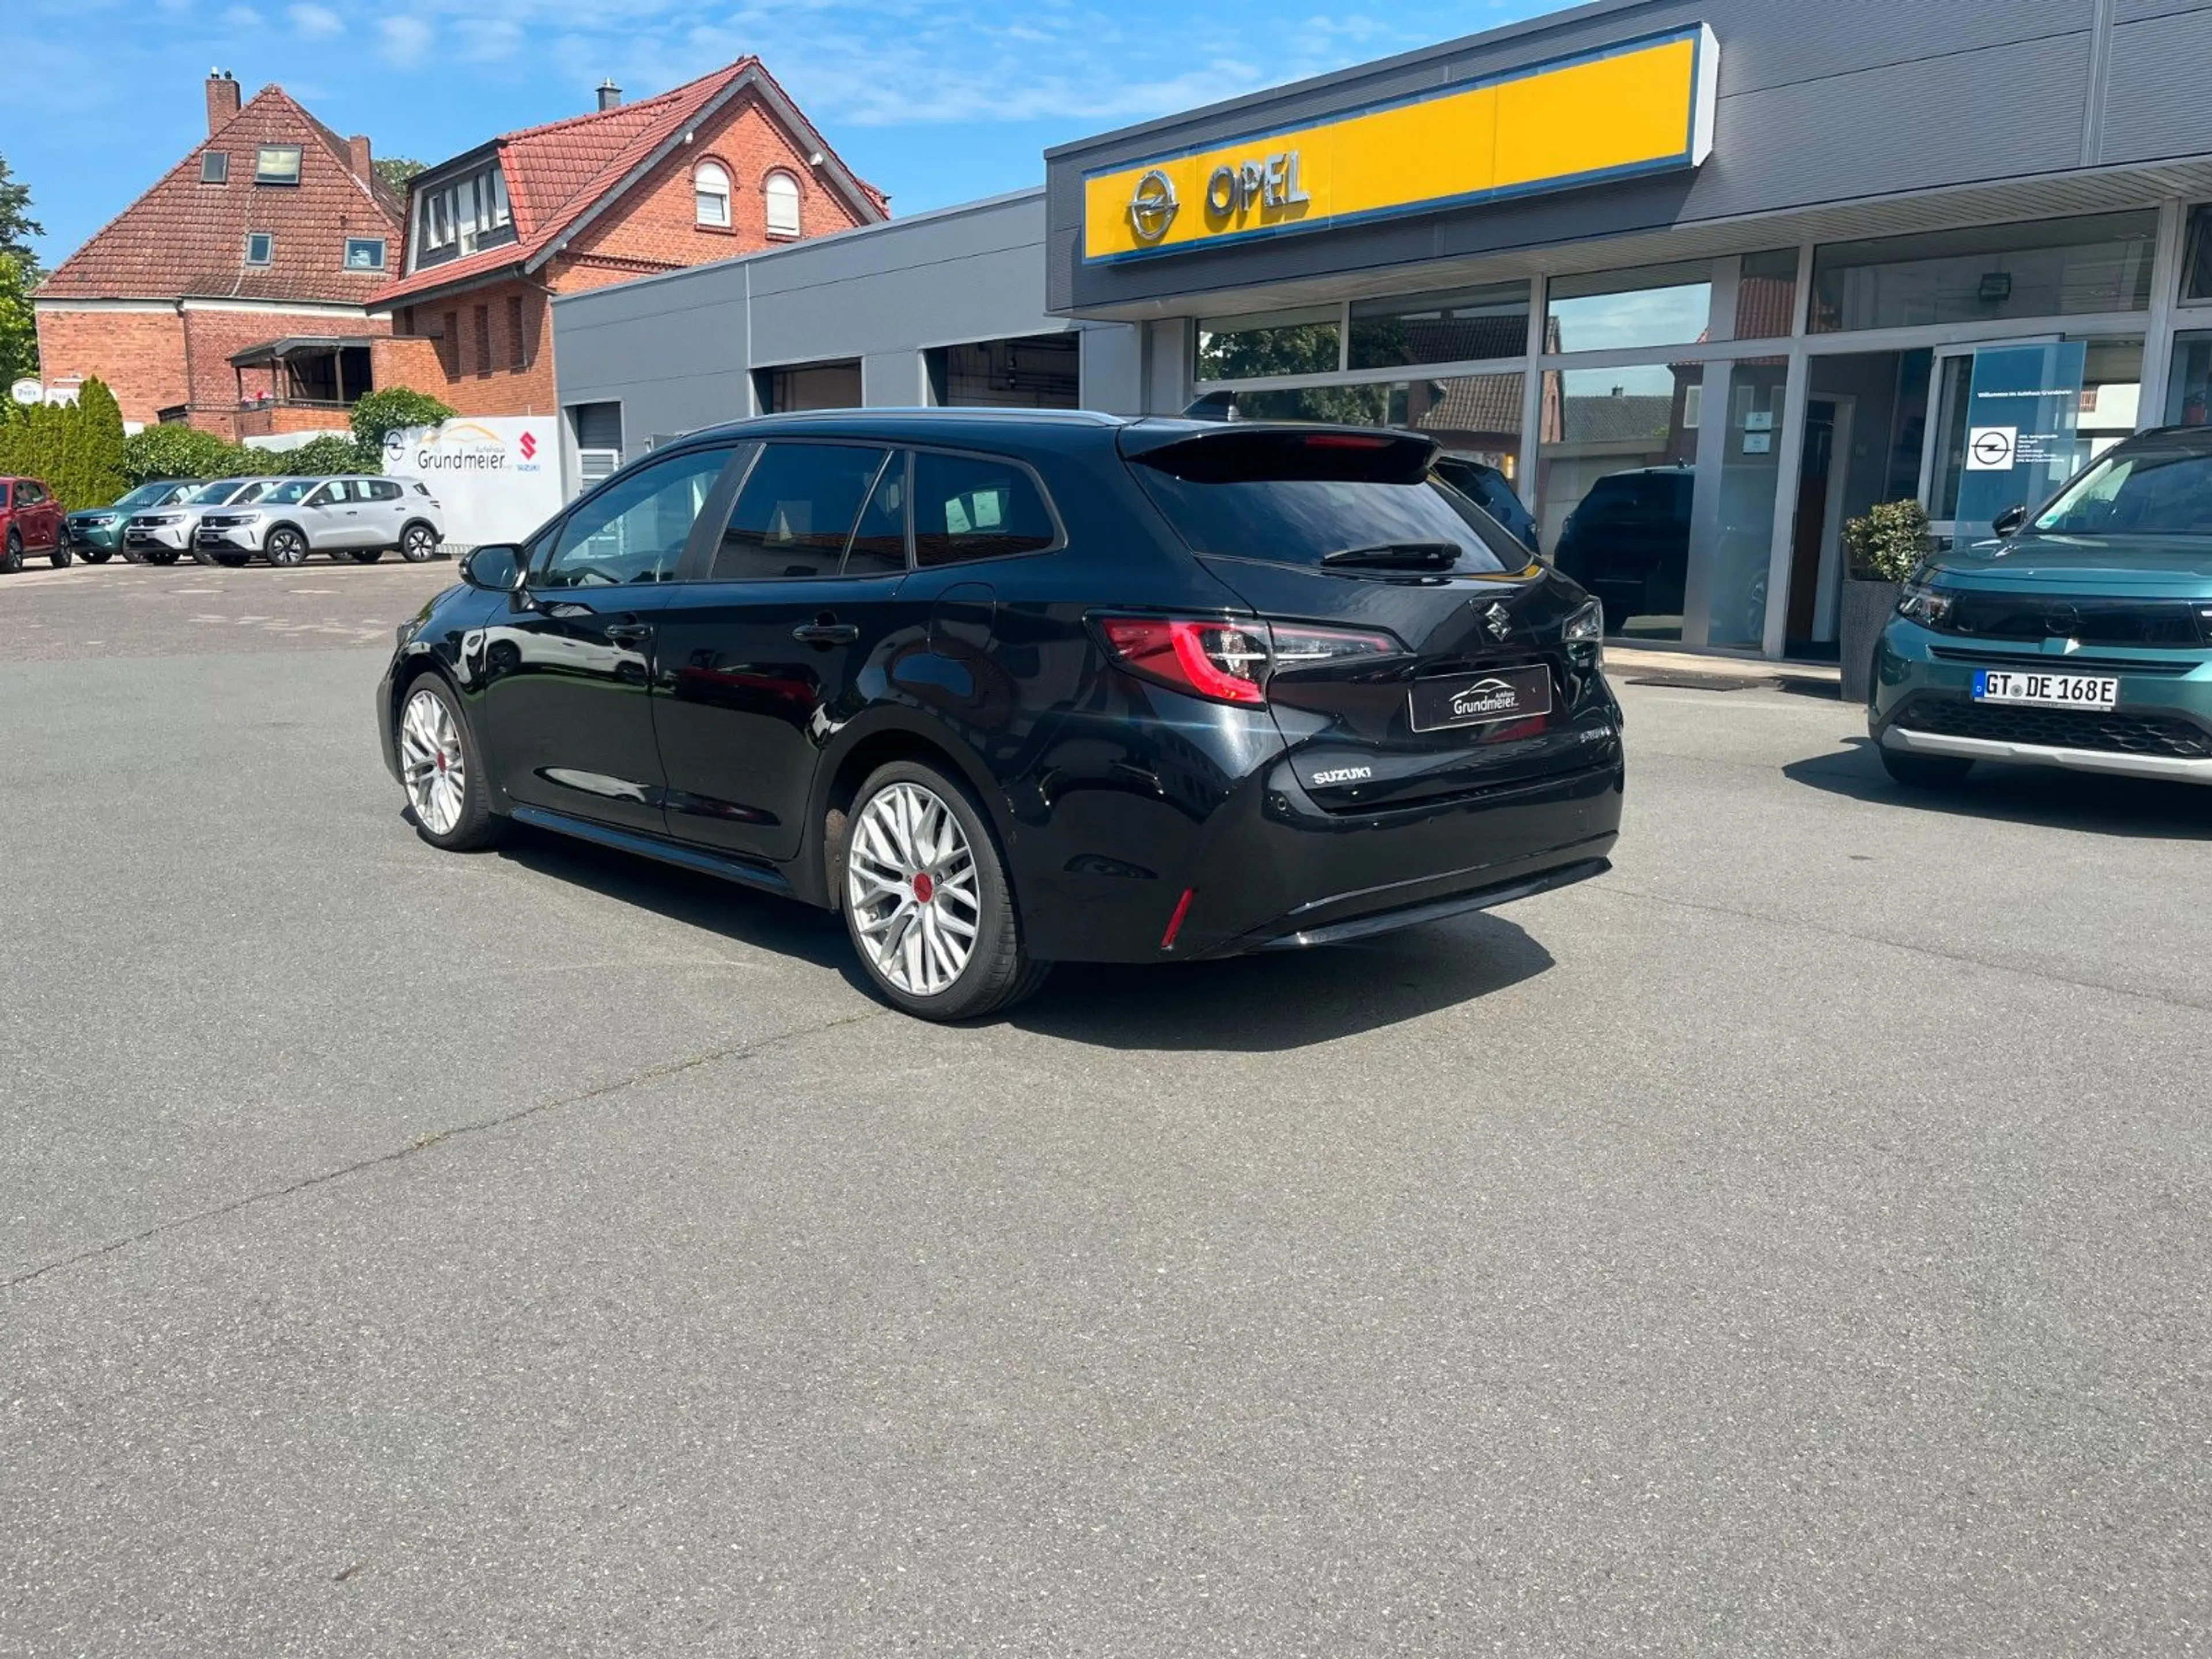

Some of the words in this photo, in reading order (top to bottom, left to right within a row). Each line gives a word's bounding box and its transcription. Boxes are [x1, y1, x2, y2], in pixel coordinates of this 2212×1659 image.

[1207, 150, 1310, 216] OPEL
[418, 448, 505, 469] Grundmeier
[1987, 674, 2012, 695] GT
[2025, 676, 2052, 698] DE
[2057, 678, 2115, 703] 168E
[1454, 695, 1515, 714] Grundmeier
[1312, 767, 1371, 785] SUZUKI
